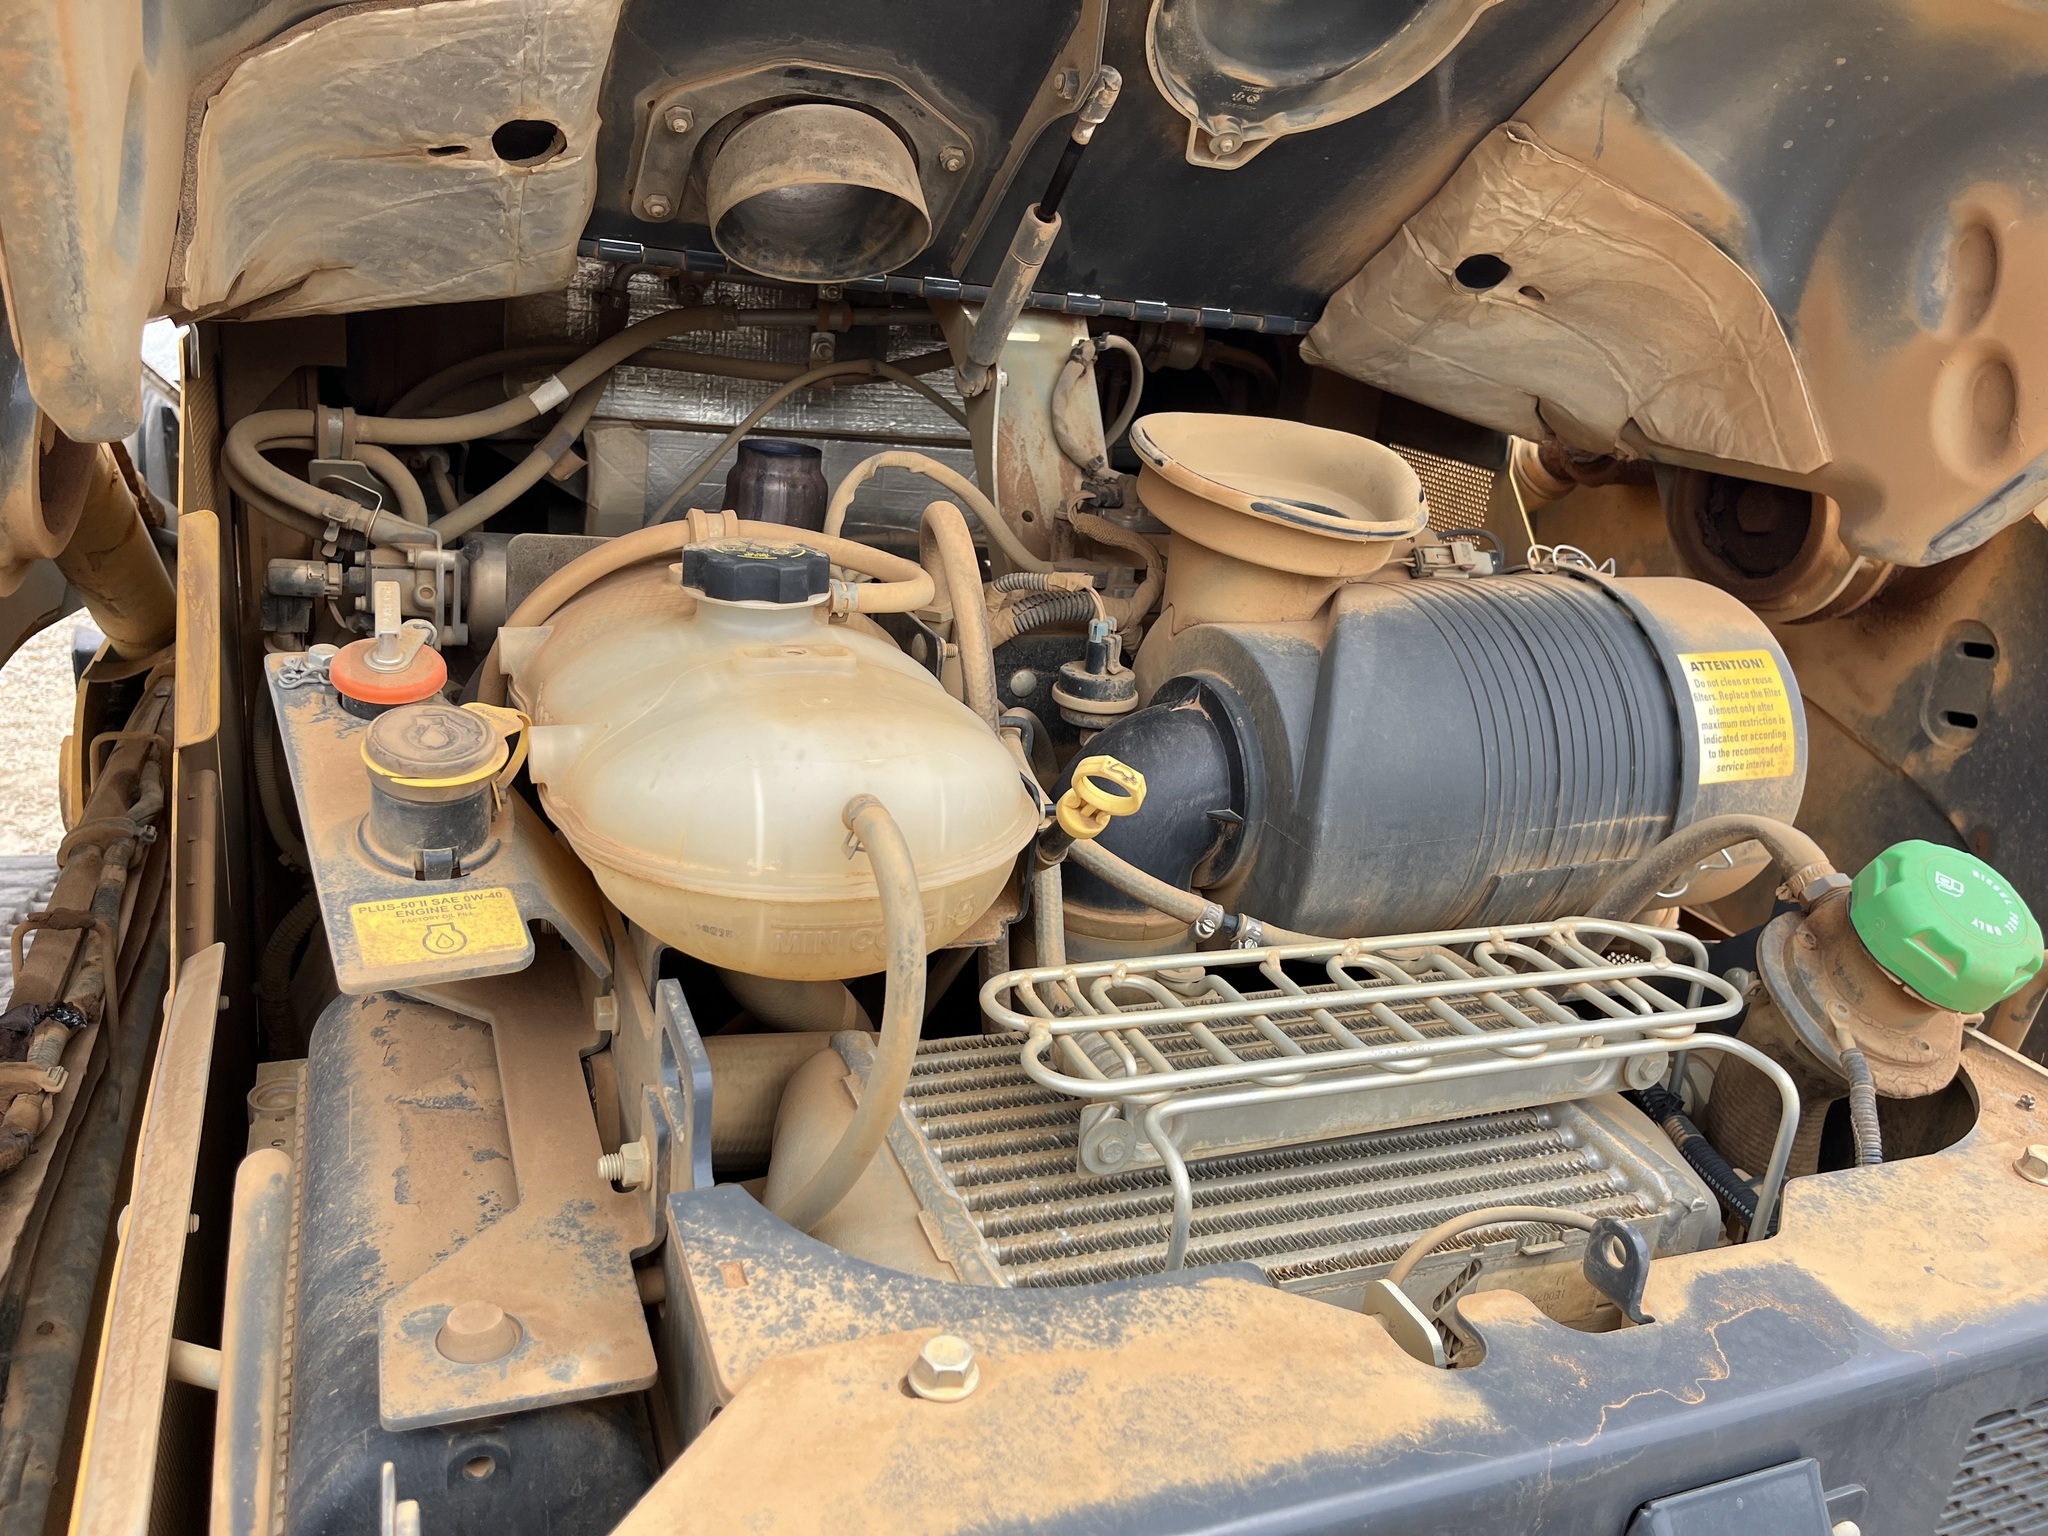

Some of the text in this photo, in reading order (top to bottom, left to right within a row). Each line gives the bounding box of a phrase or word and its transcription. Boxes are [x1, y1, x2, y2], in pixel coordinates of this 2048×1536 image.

[1690, 658, 1765, 672] ATTENTION!
[1694, 676, 1773, 688] Do not clean or reuse
[1693, 688, 1781, 703] filters. Replace the filter
[1708, 702, 1774, 715] element only after
[1701, 715, 1785, 731] maximum restriction is
[1703, 729, 1786, 745] indicated or according
[1708, 743, 1783, 758] to the recommended
[1716, 758, 1775, 772] service interval.
[431, 896, 460, 906] SAE
[463, 891, 503, 902] 0W-40
[396, 903, 477, 918] ENGINE OIL
[402, 915, 439, 923] FACTORY
[2004, 911, 2019, 934] FUEL
[1971, 918, 2002, 936] ONLY
[771, 916, 936, 954] MIN CD
